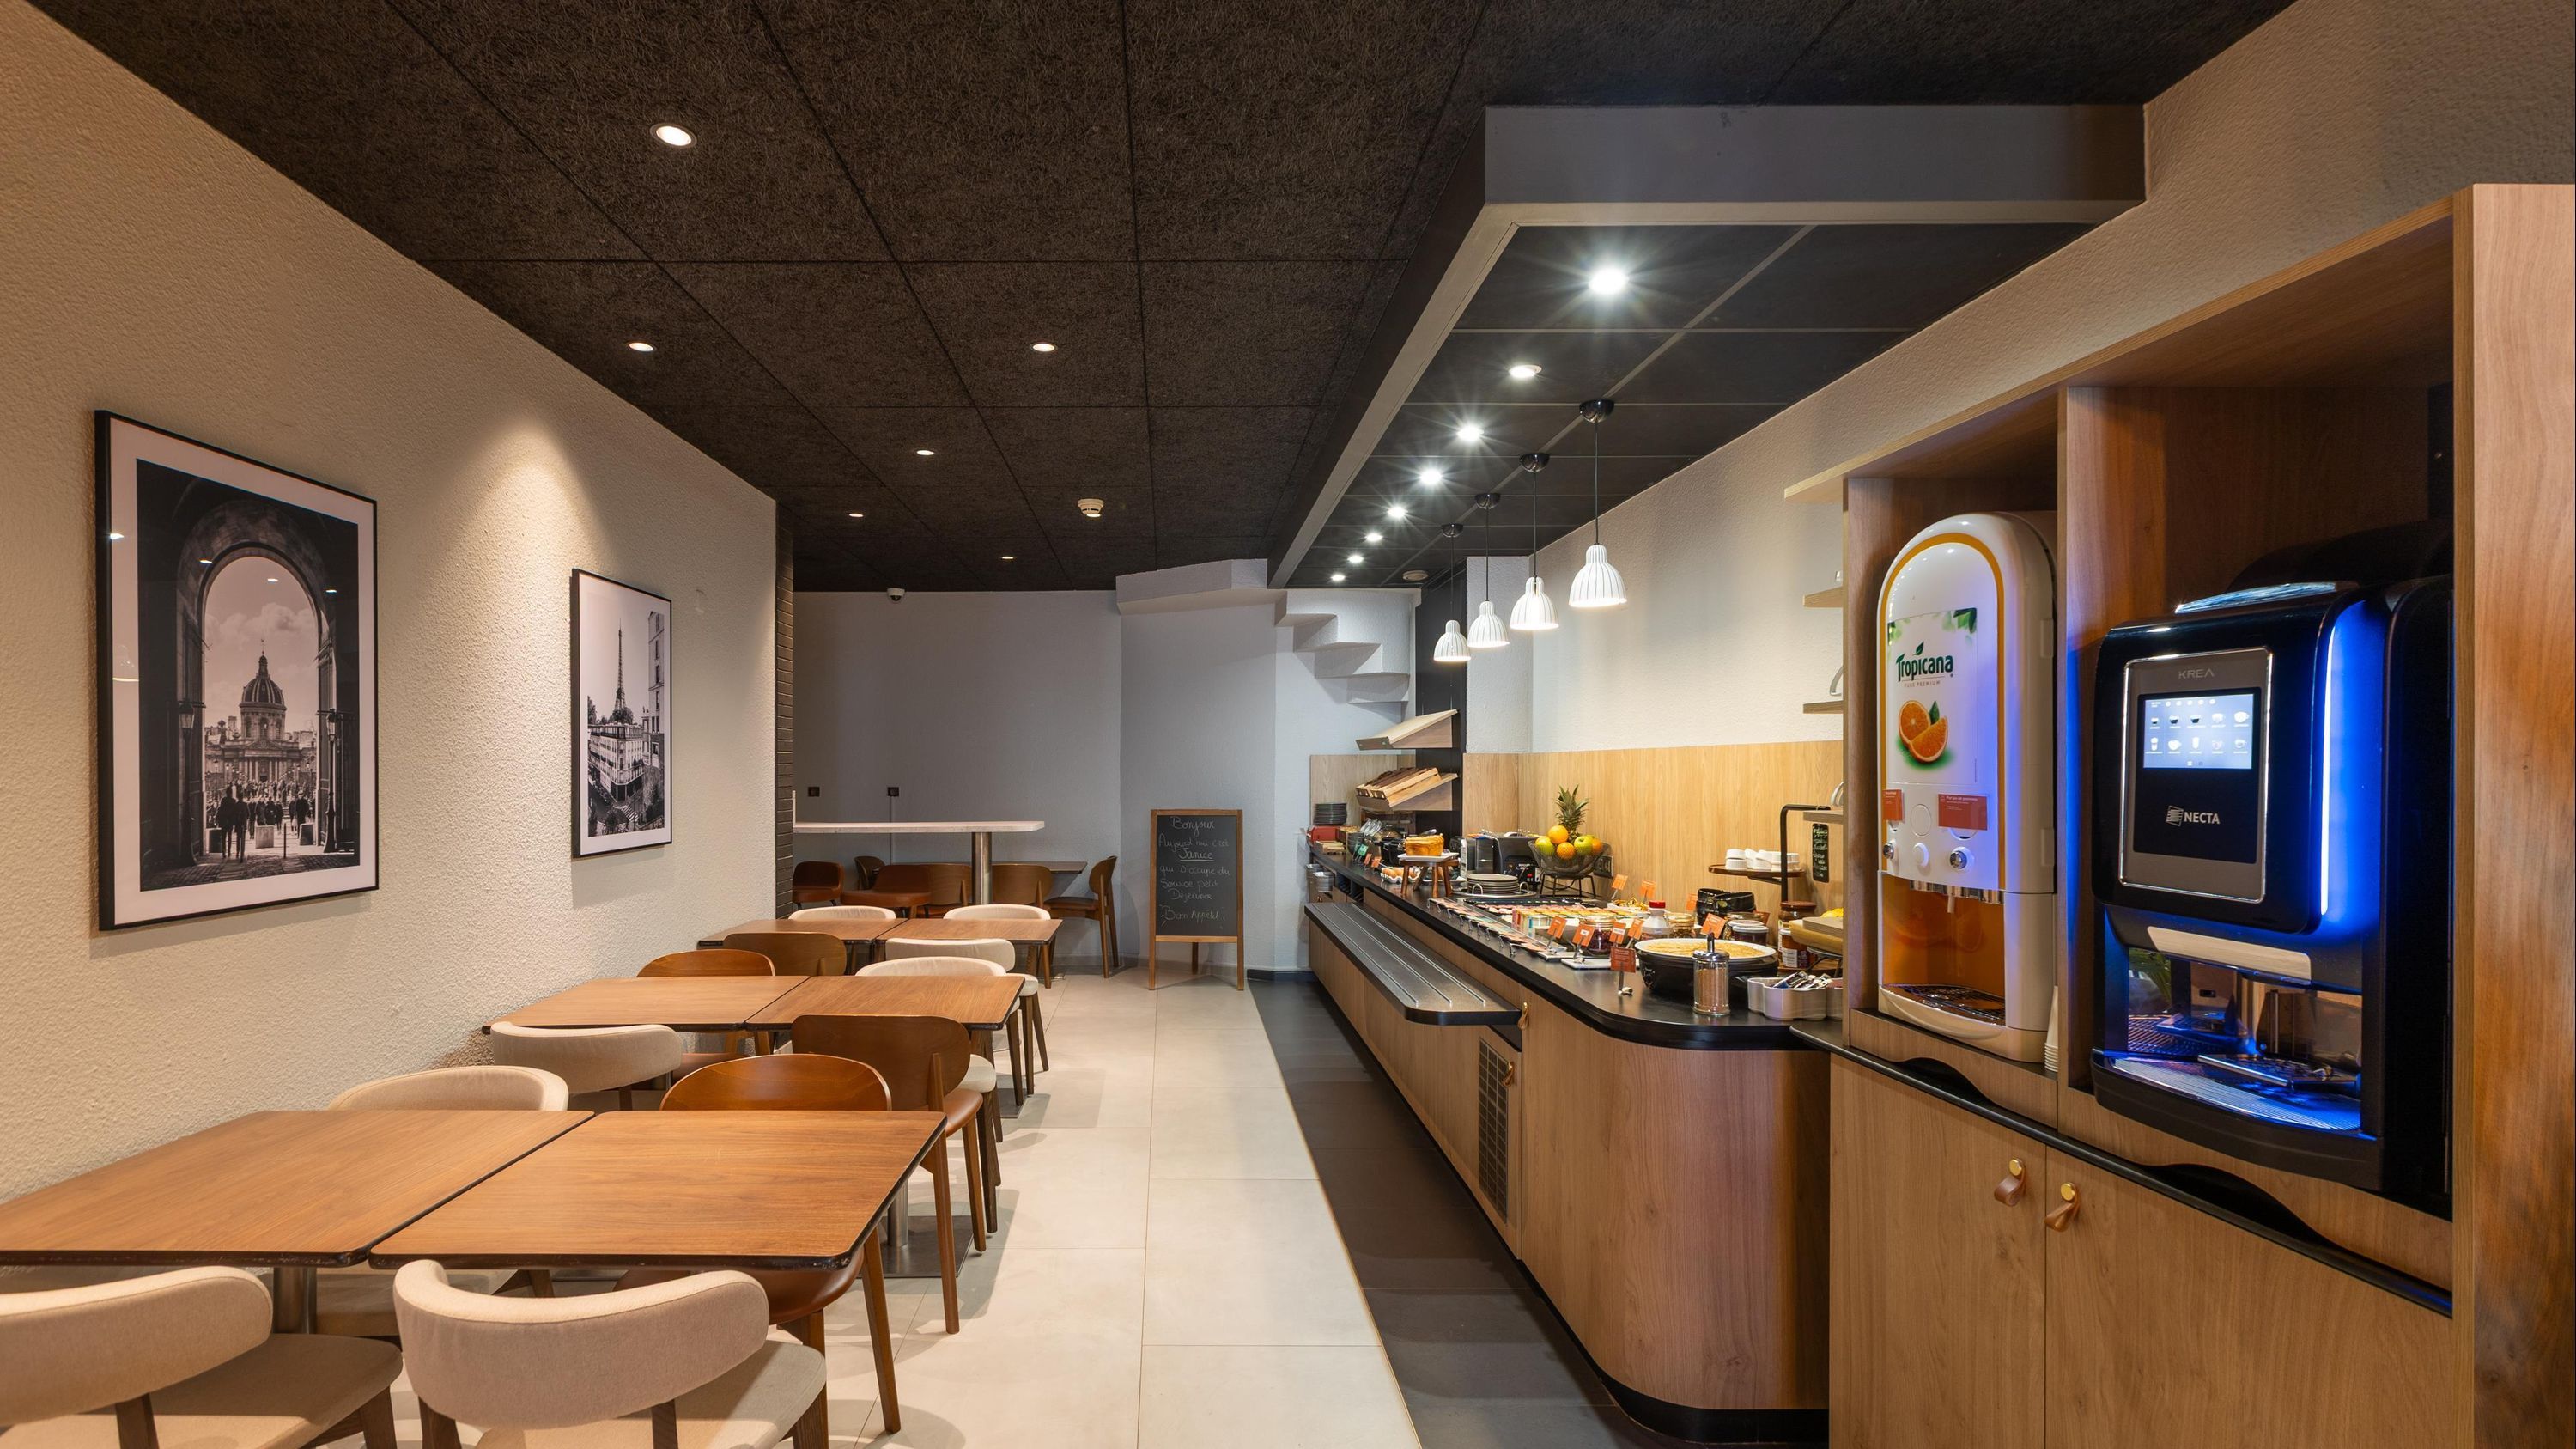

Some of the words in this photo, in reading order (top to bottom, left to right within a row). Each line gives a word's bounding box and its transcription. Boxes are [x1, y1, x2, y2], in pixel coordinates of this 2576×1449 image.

[1896, 653, 1953, 682] Tropicana
[2178, 668, 2215, 679] KREA
[2184, 812, 2221, 825] NECTA
[1170, 816, 1215, 837] Bonjour
[1178, 847, 1213, 860] Janice
[1159, 865, 1174, 877] qui
[1218, 866, 1231, 877] du
[1161, 904, 1188, 921] Bon
